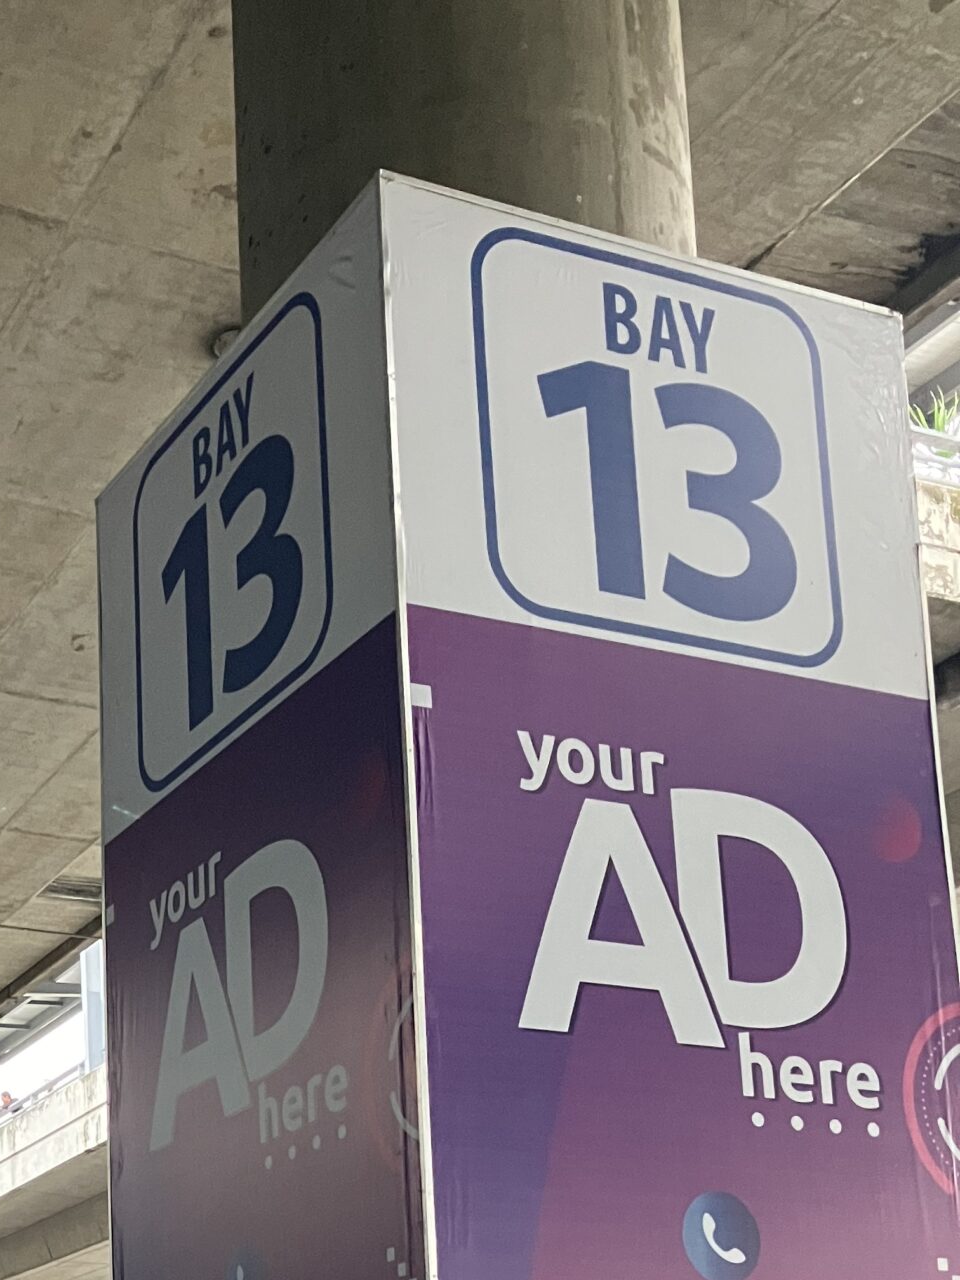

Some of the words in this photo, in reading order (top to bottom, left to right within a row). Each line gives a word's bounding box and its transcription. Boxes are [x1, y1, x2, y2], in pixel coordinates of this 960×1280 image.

[602, 282, 715, 374] BAY
[192, 374, 254, 497] BAY
[537, 360, 797, 621] 13
[162, 433, 304, 731] 13
[516, 729, 664, 796] your
[149, 851, 222, 950] your
[518, 787, 847, 1048] AD
[149, 839, 328, 1152] AD
[258, 1063, 349, 1143] here
[738, 1032, 881, 1108] here
